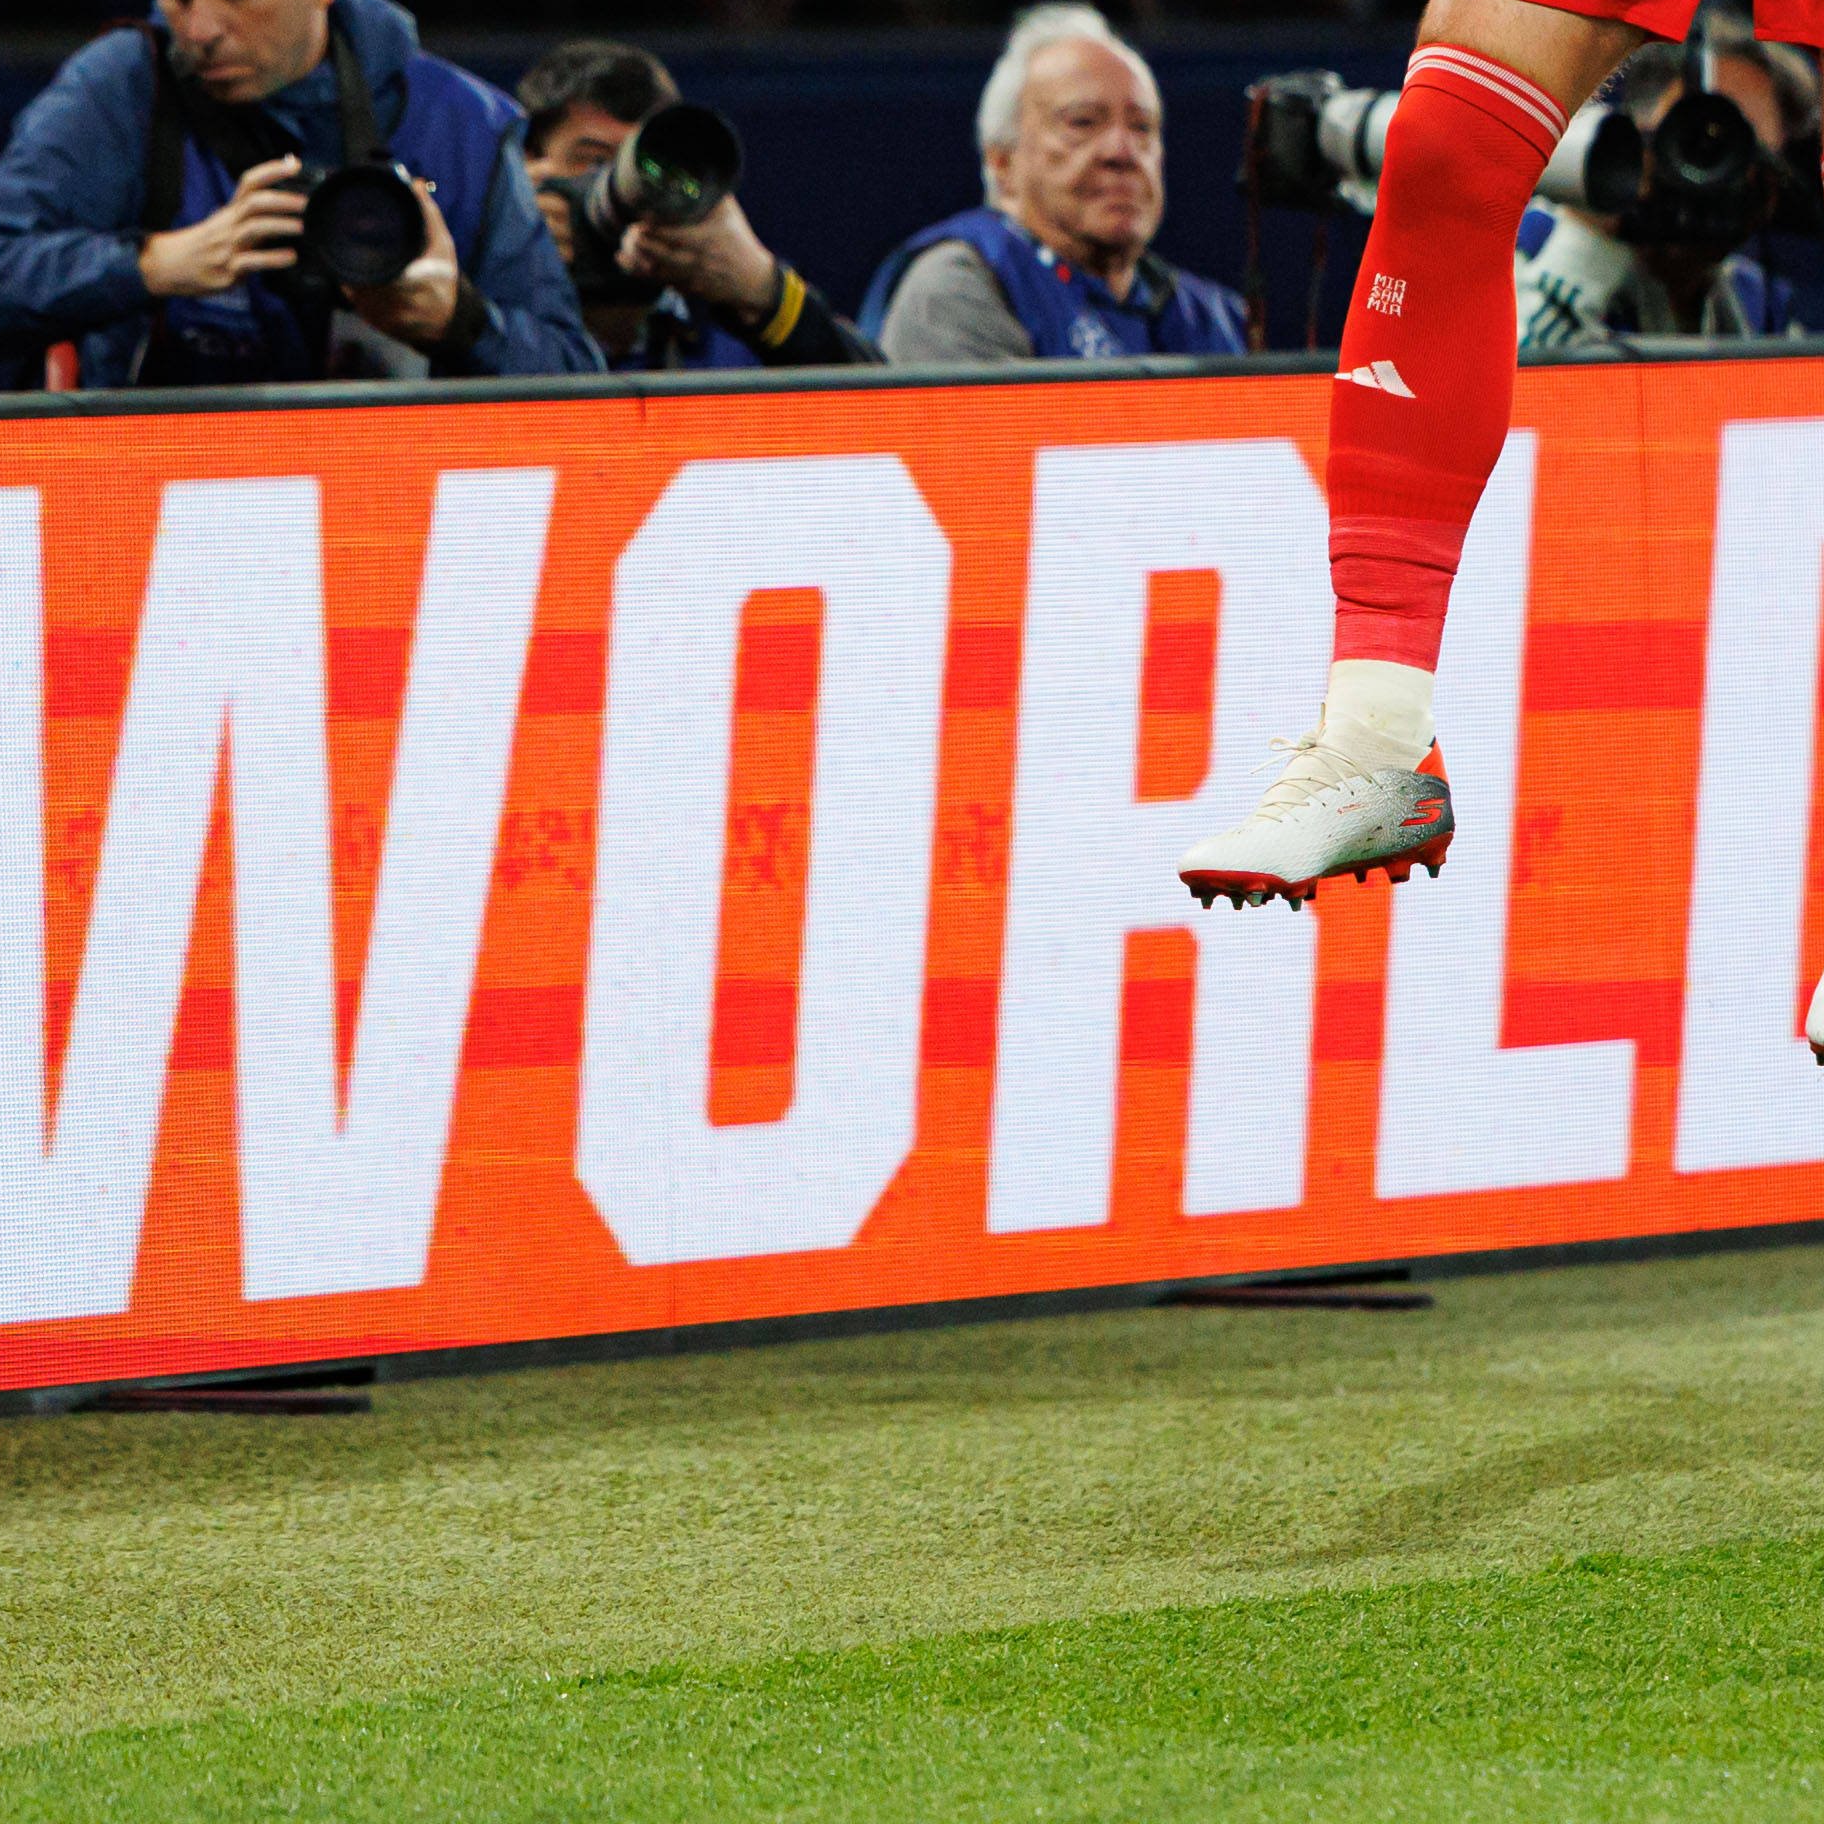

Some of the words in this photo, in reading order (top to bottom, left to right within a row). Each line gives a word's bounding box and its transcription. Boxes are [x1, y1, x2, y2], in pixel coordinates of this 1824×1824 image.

[1374, 272, 1407, 292] MIA
[1370, 285, 1405, 305] SAN
[1366, 296, 1401, 317] MIA
